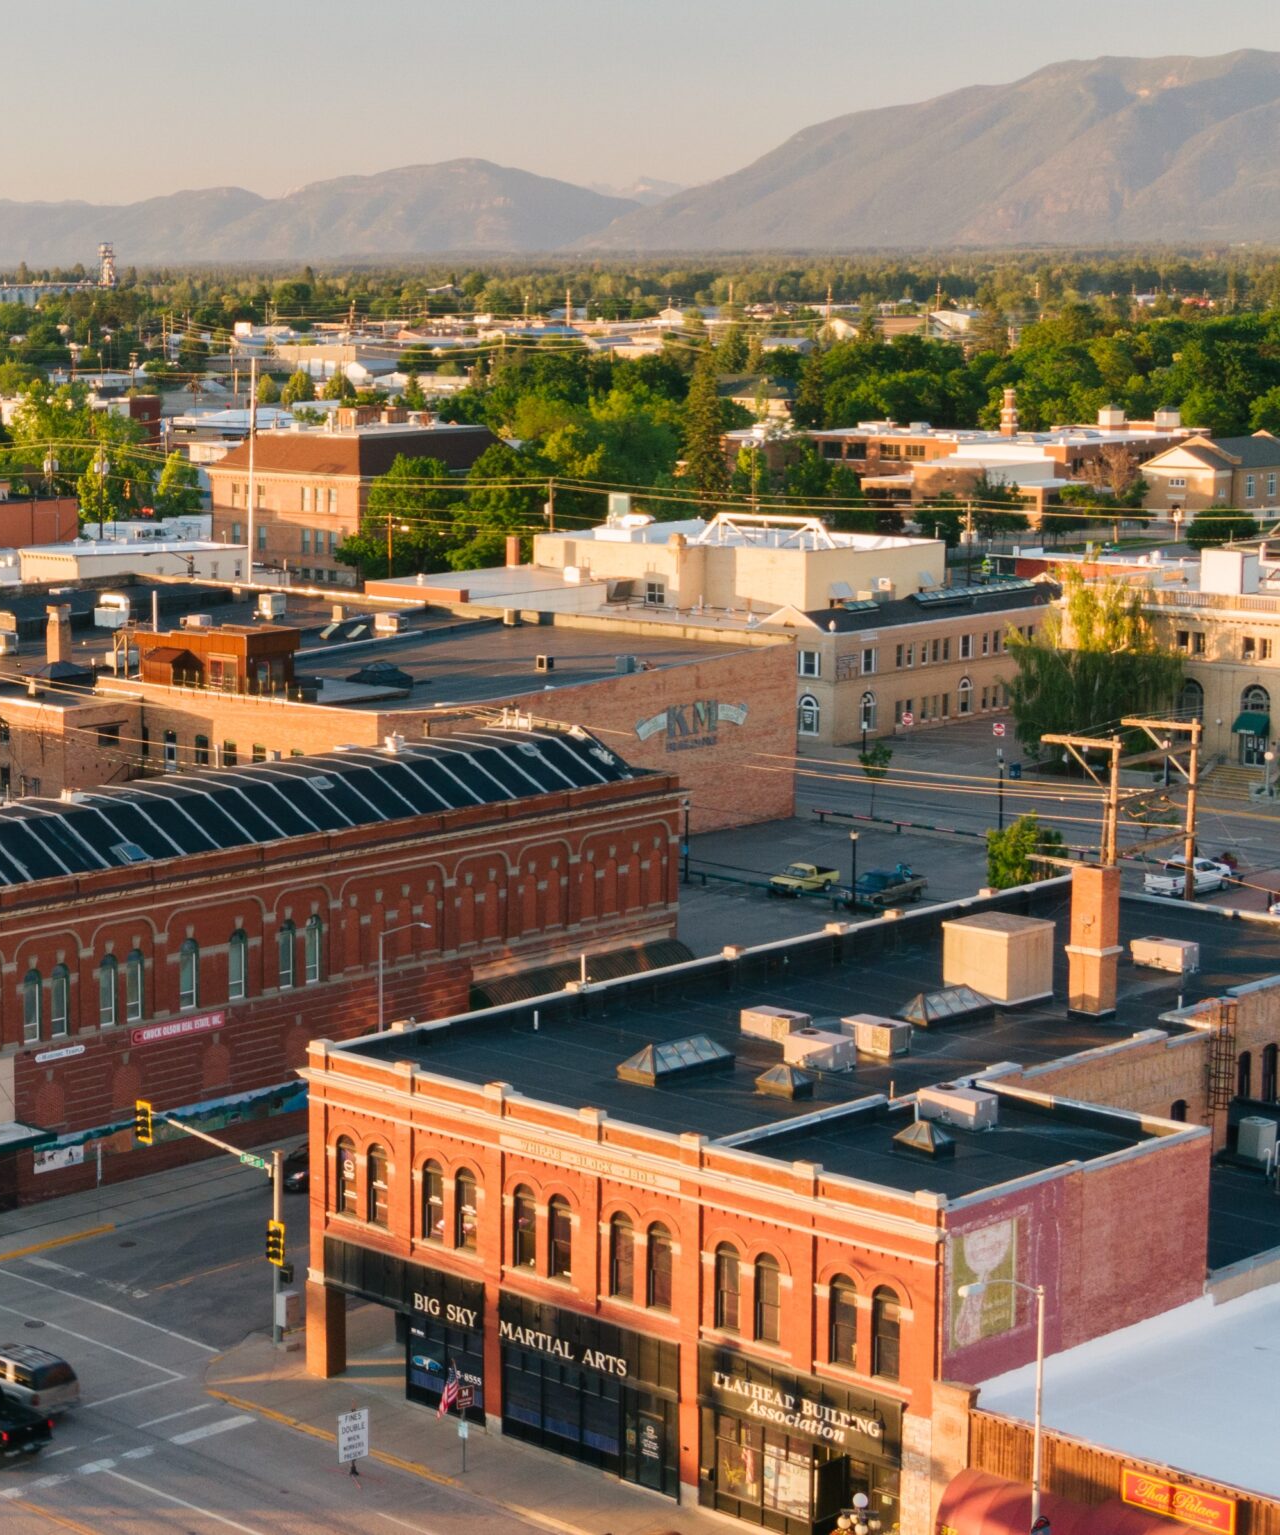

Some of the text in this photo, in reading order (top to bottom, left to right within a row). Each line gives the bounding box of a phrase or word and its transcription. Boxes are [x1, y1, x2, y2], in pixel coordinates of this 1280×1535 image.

[667, 699, 718, 737] KM
[143, 1027, 162, 1040] CHUCK
[162, 1023, 181, 1036] OLSON
[414, 1292, 477, 1328] BIG SKY
[499, 1320, 627, 1377] MARTIAL ARTS
[462, 1388, 469, 1397] M
[342, 1421, 366, 1434] DOUBLE
[345, 1411, 361, 1423] FINES
[746, 1399, 845, 1444] Association
[1134, 1479, 1169, 1503] Thai
[1172, 1491, 1220, 1520] Palace
